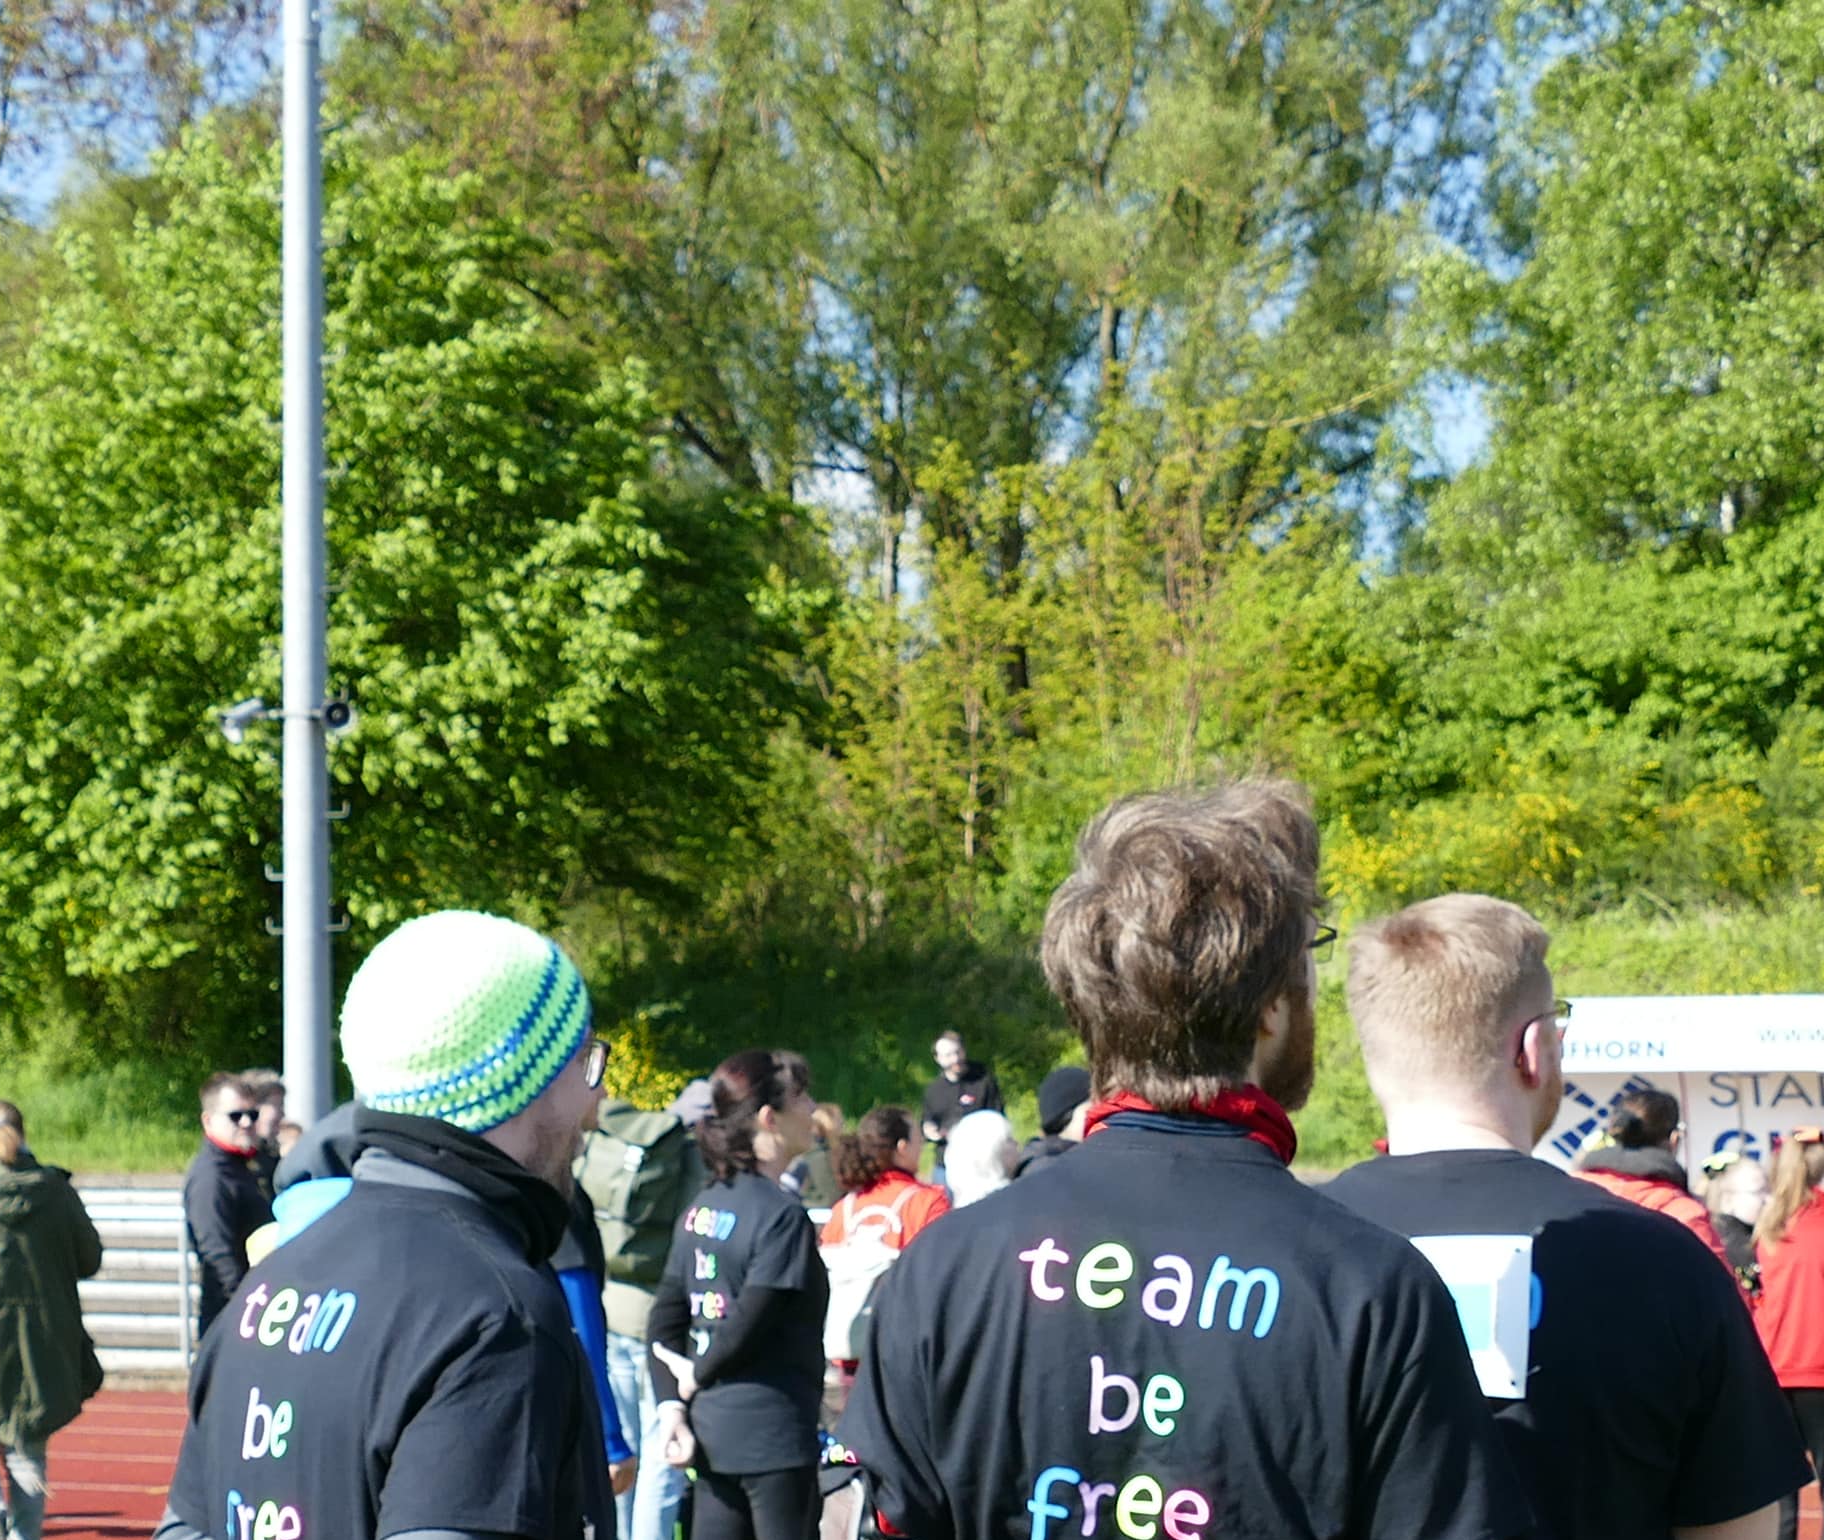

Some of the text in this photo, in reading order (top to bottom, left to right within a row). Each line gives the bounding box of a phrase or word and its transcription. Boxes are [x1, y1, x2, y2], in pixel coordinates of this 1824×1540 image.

[684, 1206, 736, 1241] team
[239, 1283, 357, 1355] team
[689, 1290, 726, 1320] ree
[1018, 1237, 1280, 1338] team
[242, 1386, 294, 1461] be
[1088, 1355, 1185, 1436] be
